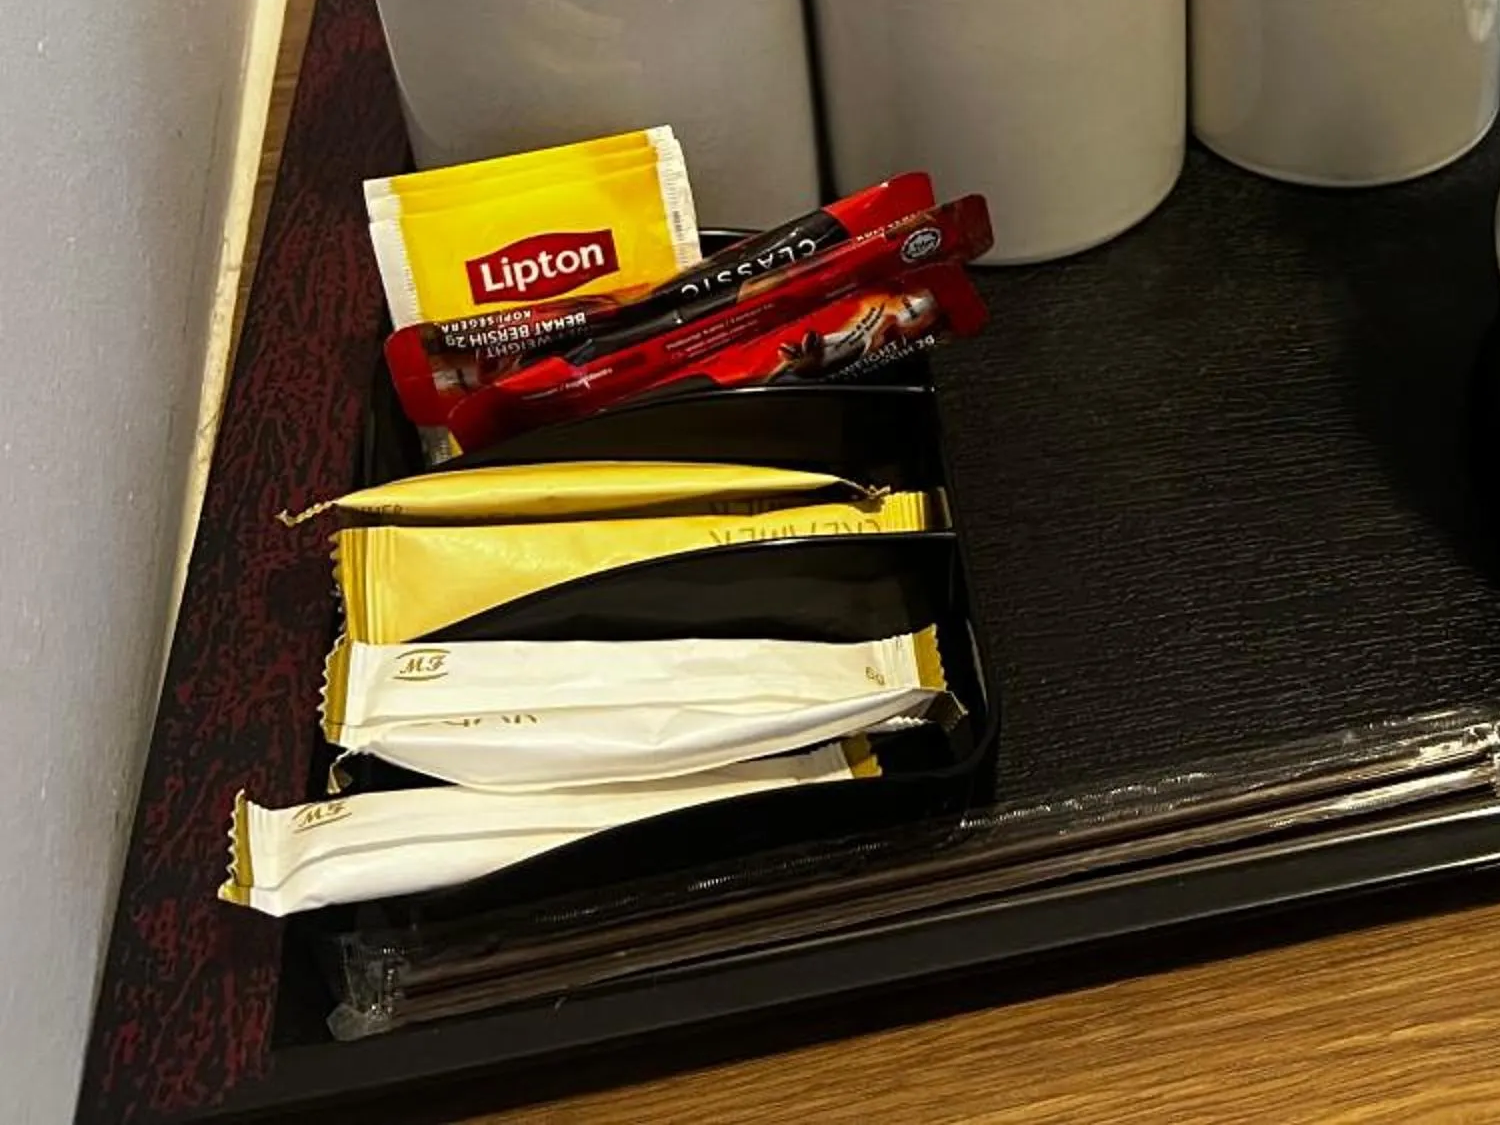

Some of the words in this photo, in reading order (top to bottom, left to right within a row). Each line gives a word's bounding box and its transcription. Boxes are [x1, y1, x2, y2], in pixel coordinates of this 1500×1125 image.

[480, 243, 605, 292] Lipton
[681, 238, 817, 296] CLASSIC
[499, 309, 532, 325] KOPI
[445, 333, 467, 349] 2g
[469, 324, 530, 348] BERSIH
